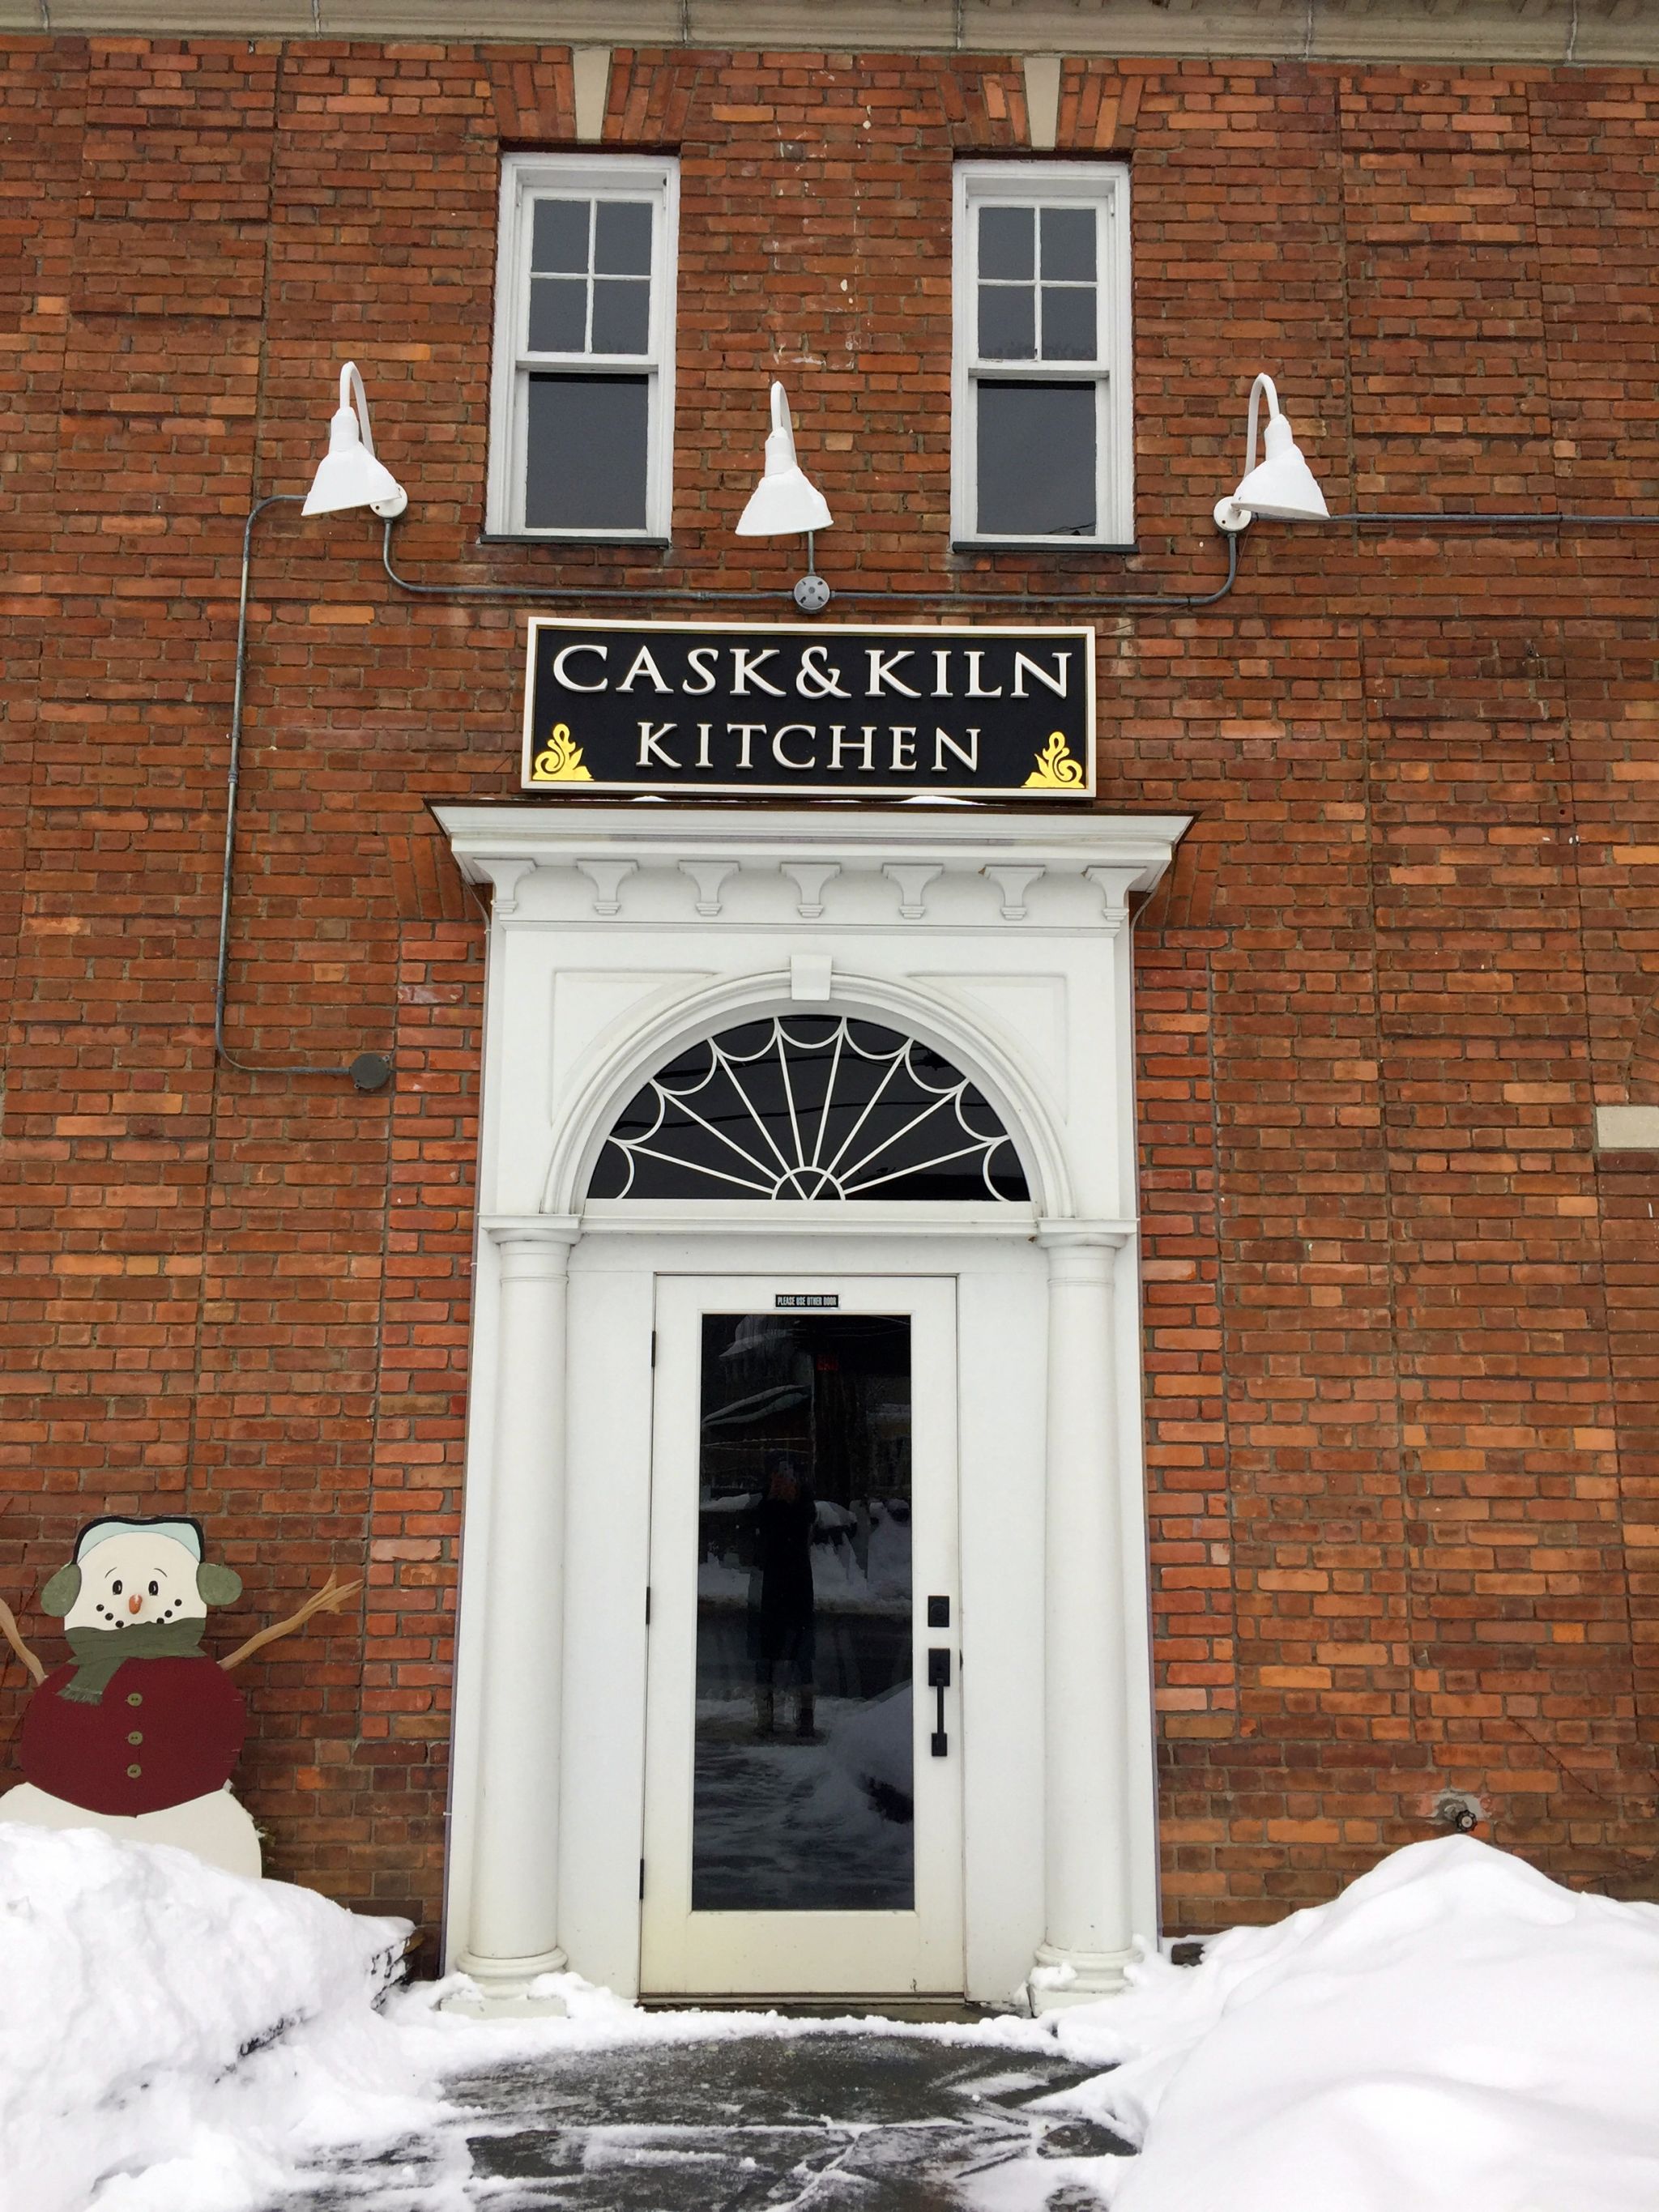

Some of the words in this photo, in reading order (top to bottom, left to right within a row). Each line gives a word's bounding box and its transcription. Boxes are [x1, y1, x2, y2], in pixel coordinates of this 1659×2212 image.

[636, 722, 982, 772] KITCHEN
[777, 1296, 795, 1306] PLEASE
[795, 1296, 806, 1306] USE
[806, 1296, 822, 1306] OTHER
[823, 1296, 837, 1306] DOOR
